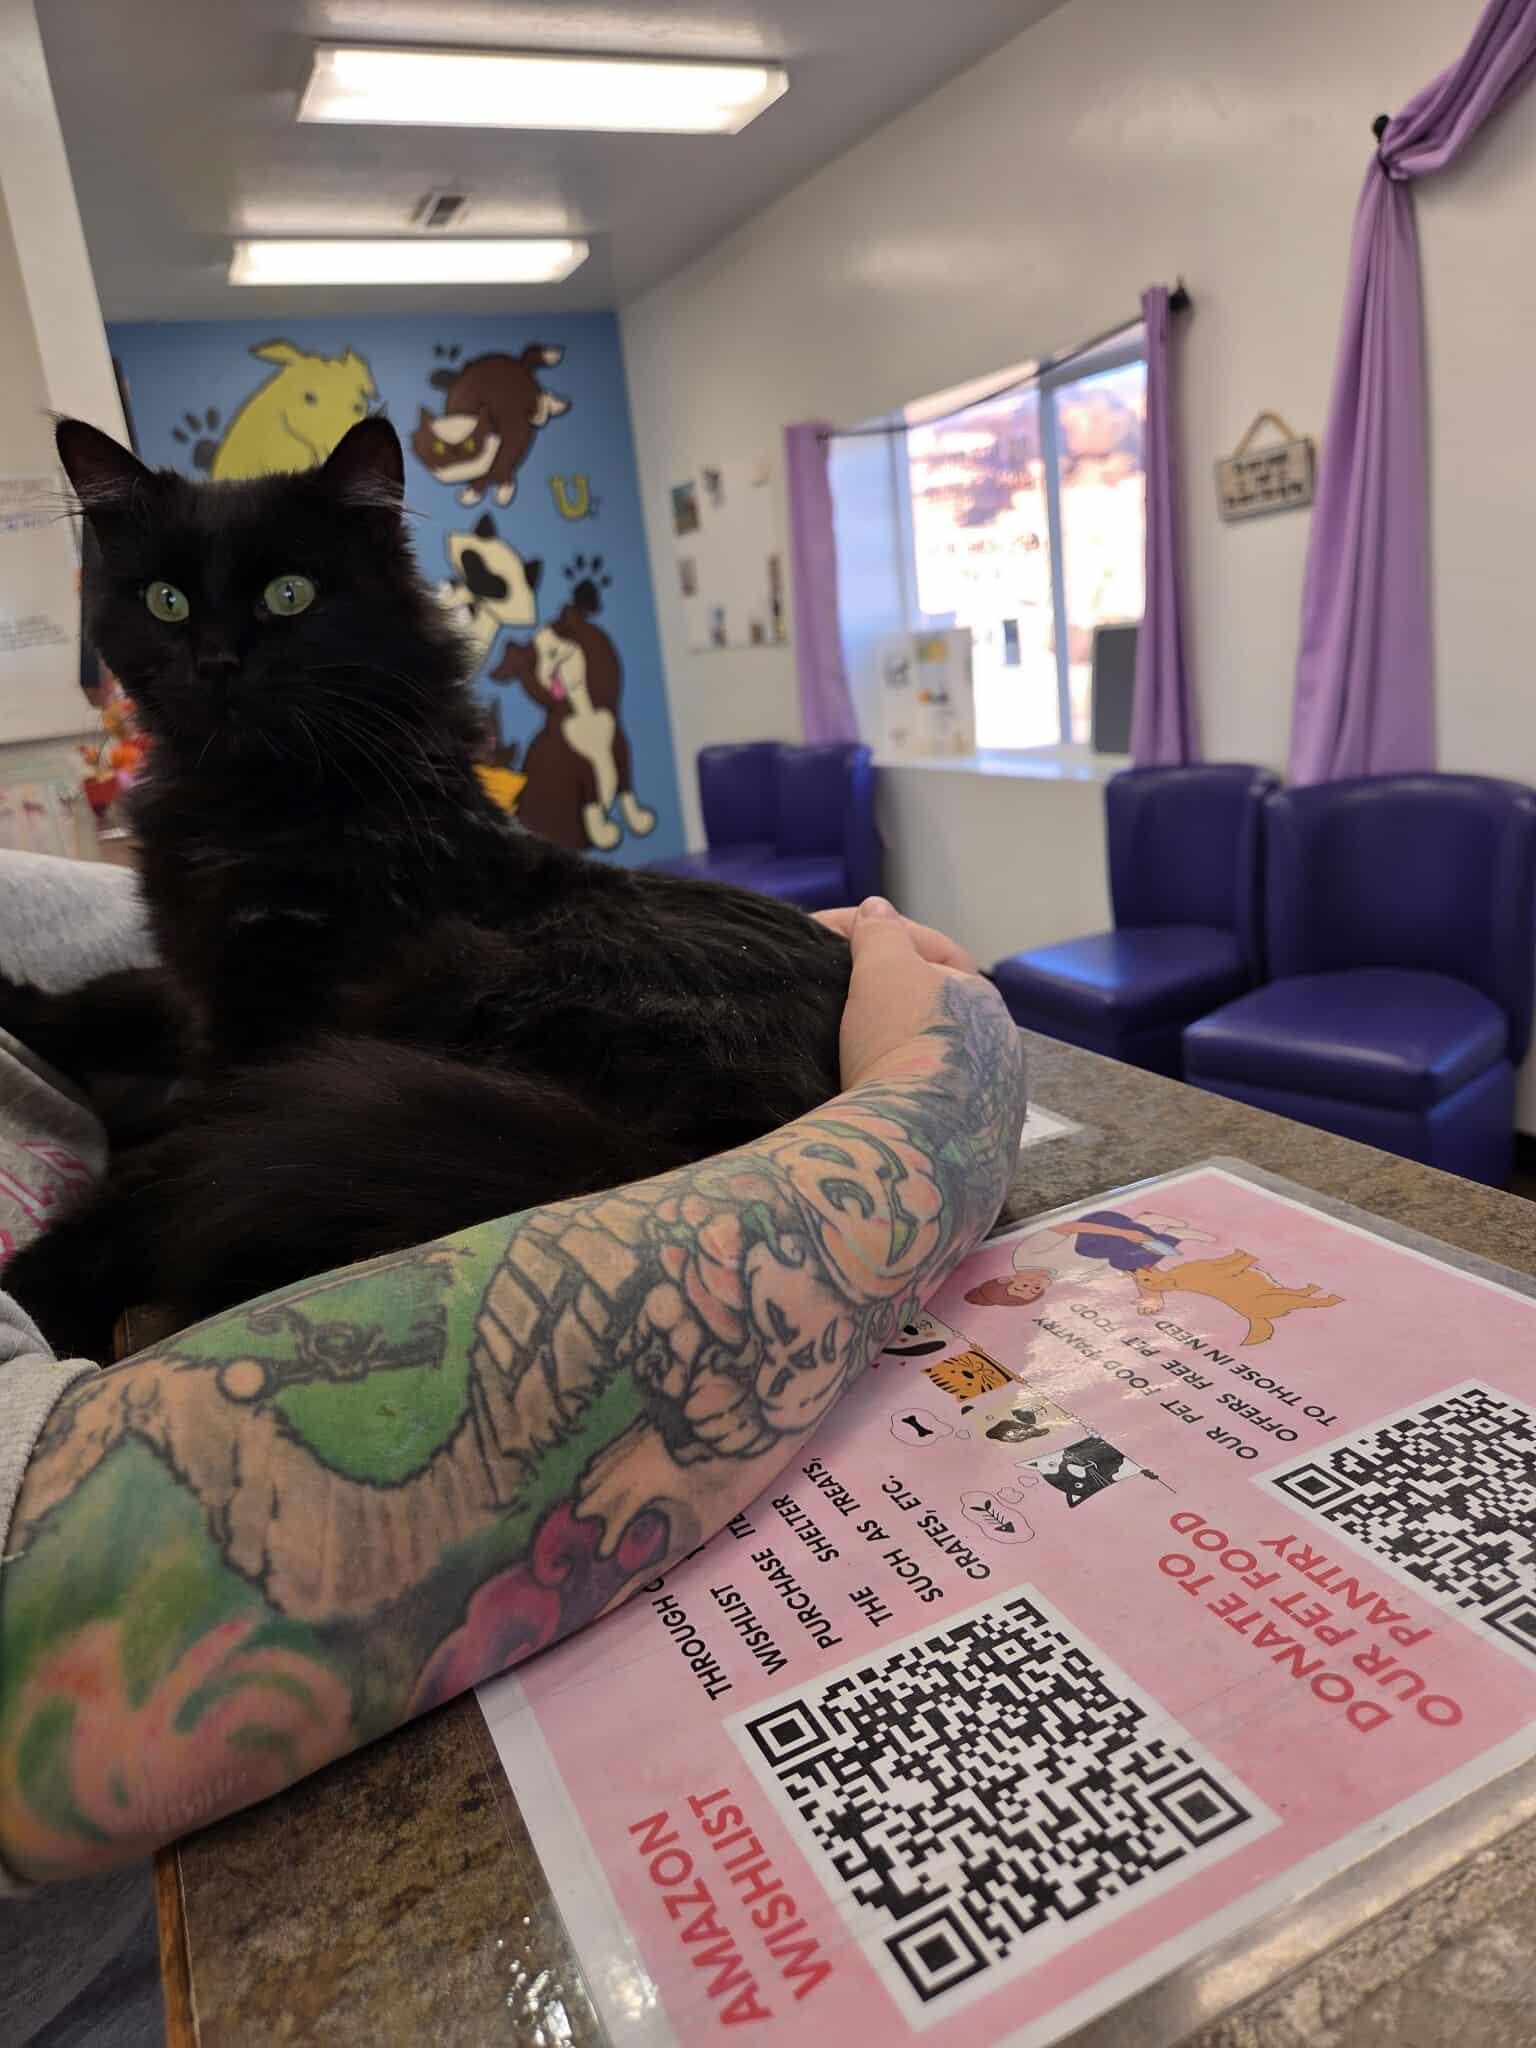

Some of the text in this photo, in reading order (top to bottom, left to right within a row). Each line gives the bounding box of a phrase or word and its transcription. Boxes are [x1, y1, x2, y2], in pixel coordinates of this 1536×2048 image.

[1032, 1318, 1259, 1459] OUR PET FOOD PANTRY
[1070, 1304, 1298, 1442] OFFERS FREE PET FOOD
[1155, 1320, 1339, 1427] TO THOSE IN NEED
[771, 1494, 893, 1627] THE SHELTER
[802, 1457, 943, 1603] SUCH AS TREATS,
[882, 1475, 991, 1580] CRATES, ETC.
[1259, 1534, 1433, 1648] PANTRY
[652, 1594, 733, 1700] THROUGH
[710, 1584, 788, 1676] WISHLIST
[751, 1548, 843, 1650] PURCHASE
[1158, 1553, 1392, 1733] DONATE TO
[1169, 1512, 1463, 1726] OUR PET FOOD
[628, 1811, 774, 2025] AMAZON
[688, 1788, 833, 2001] WISHLIST
